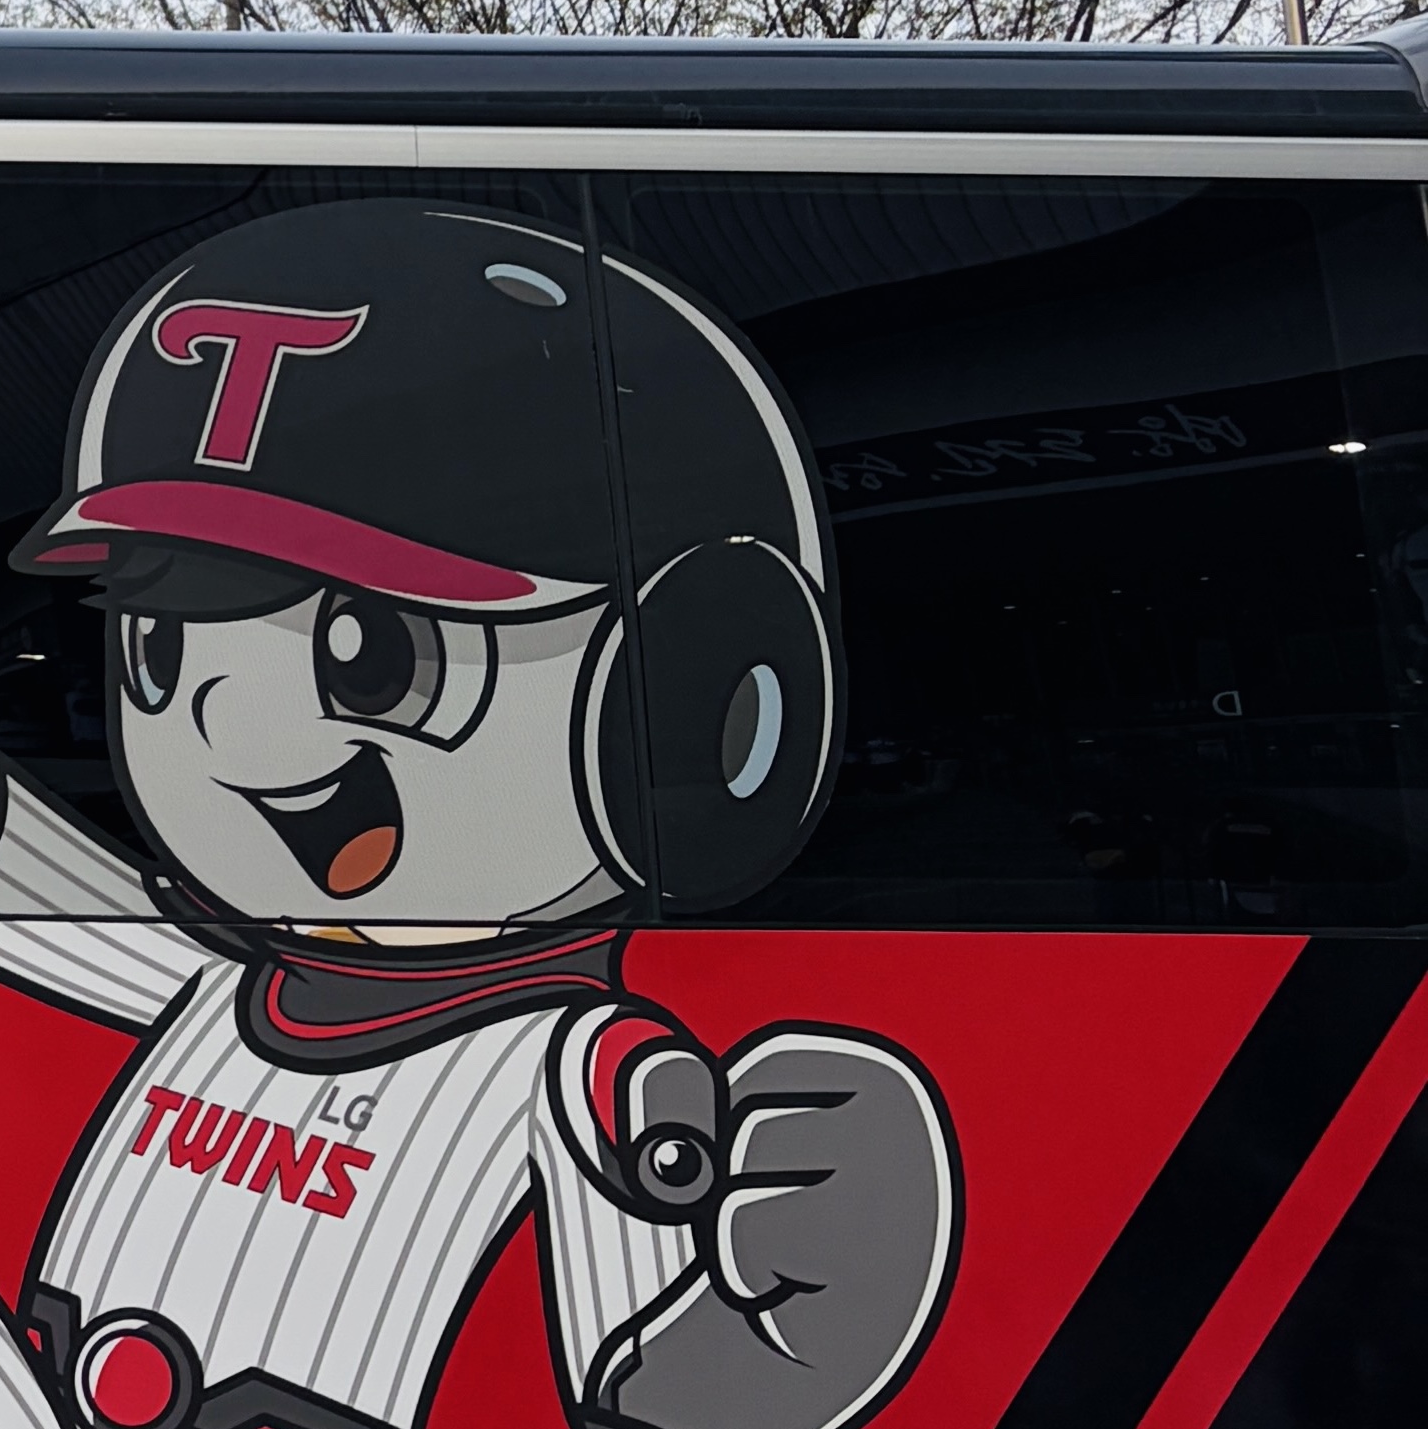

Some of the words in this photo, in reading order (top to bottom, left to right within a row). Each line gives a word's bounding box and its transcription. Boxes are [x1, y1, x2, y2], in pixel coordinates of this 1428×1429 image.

[152, 298, 370, 472] T
[131, 1084, 377, 1220] TWINS
[318, 1085, 379, 1132] LG
